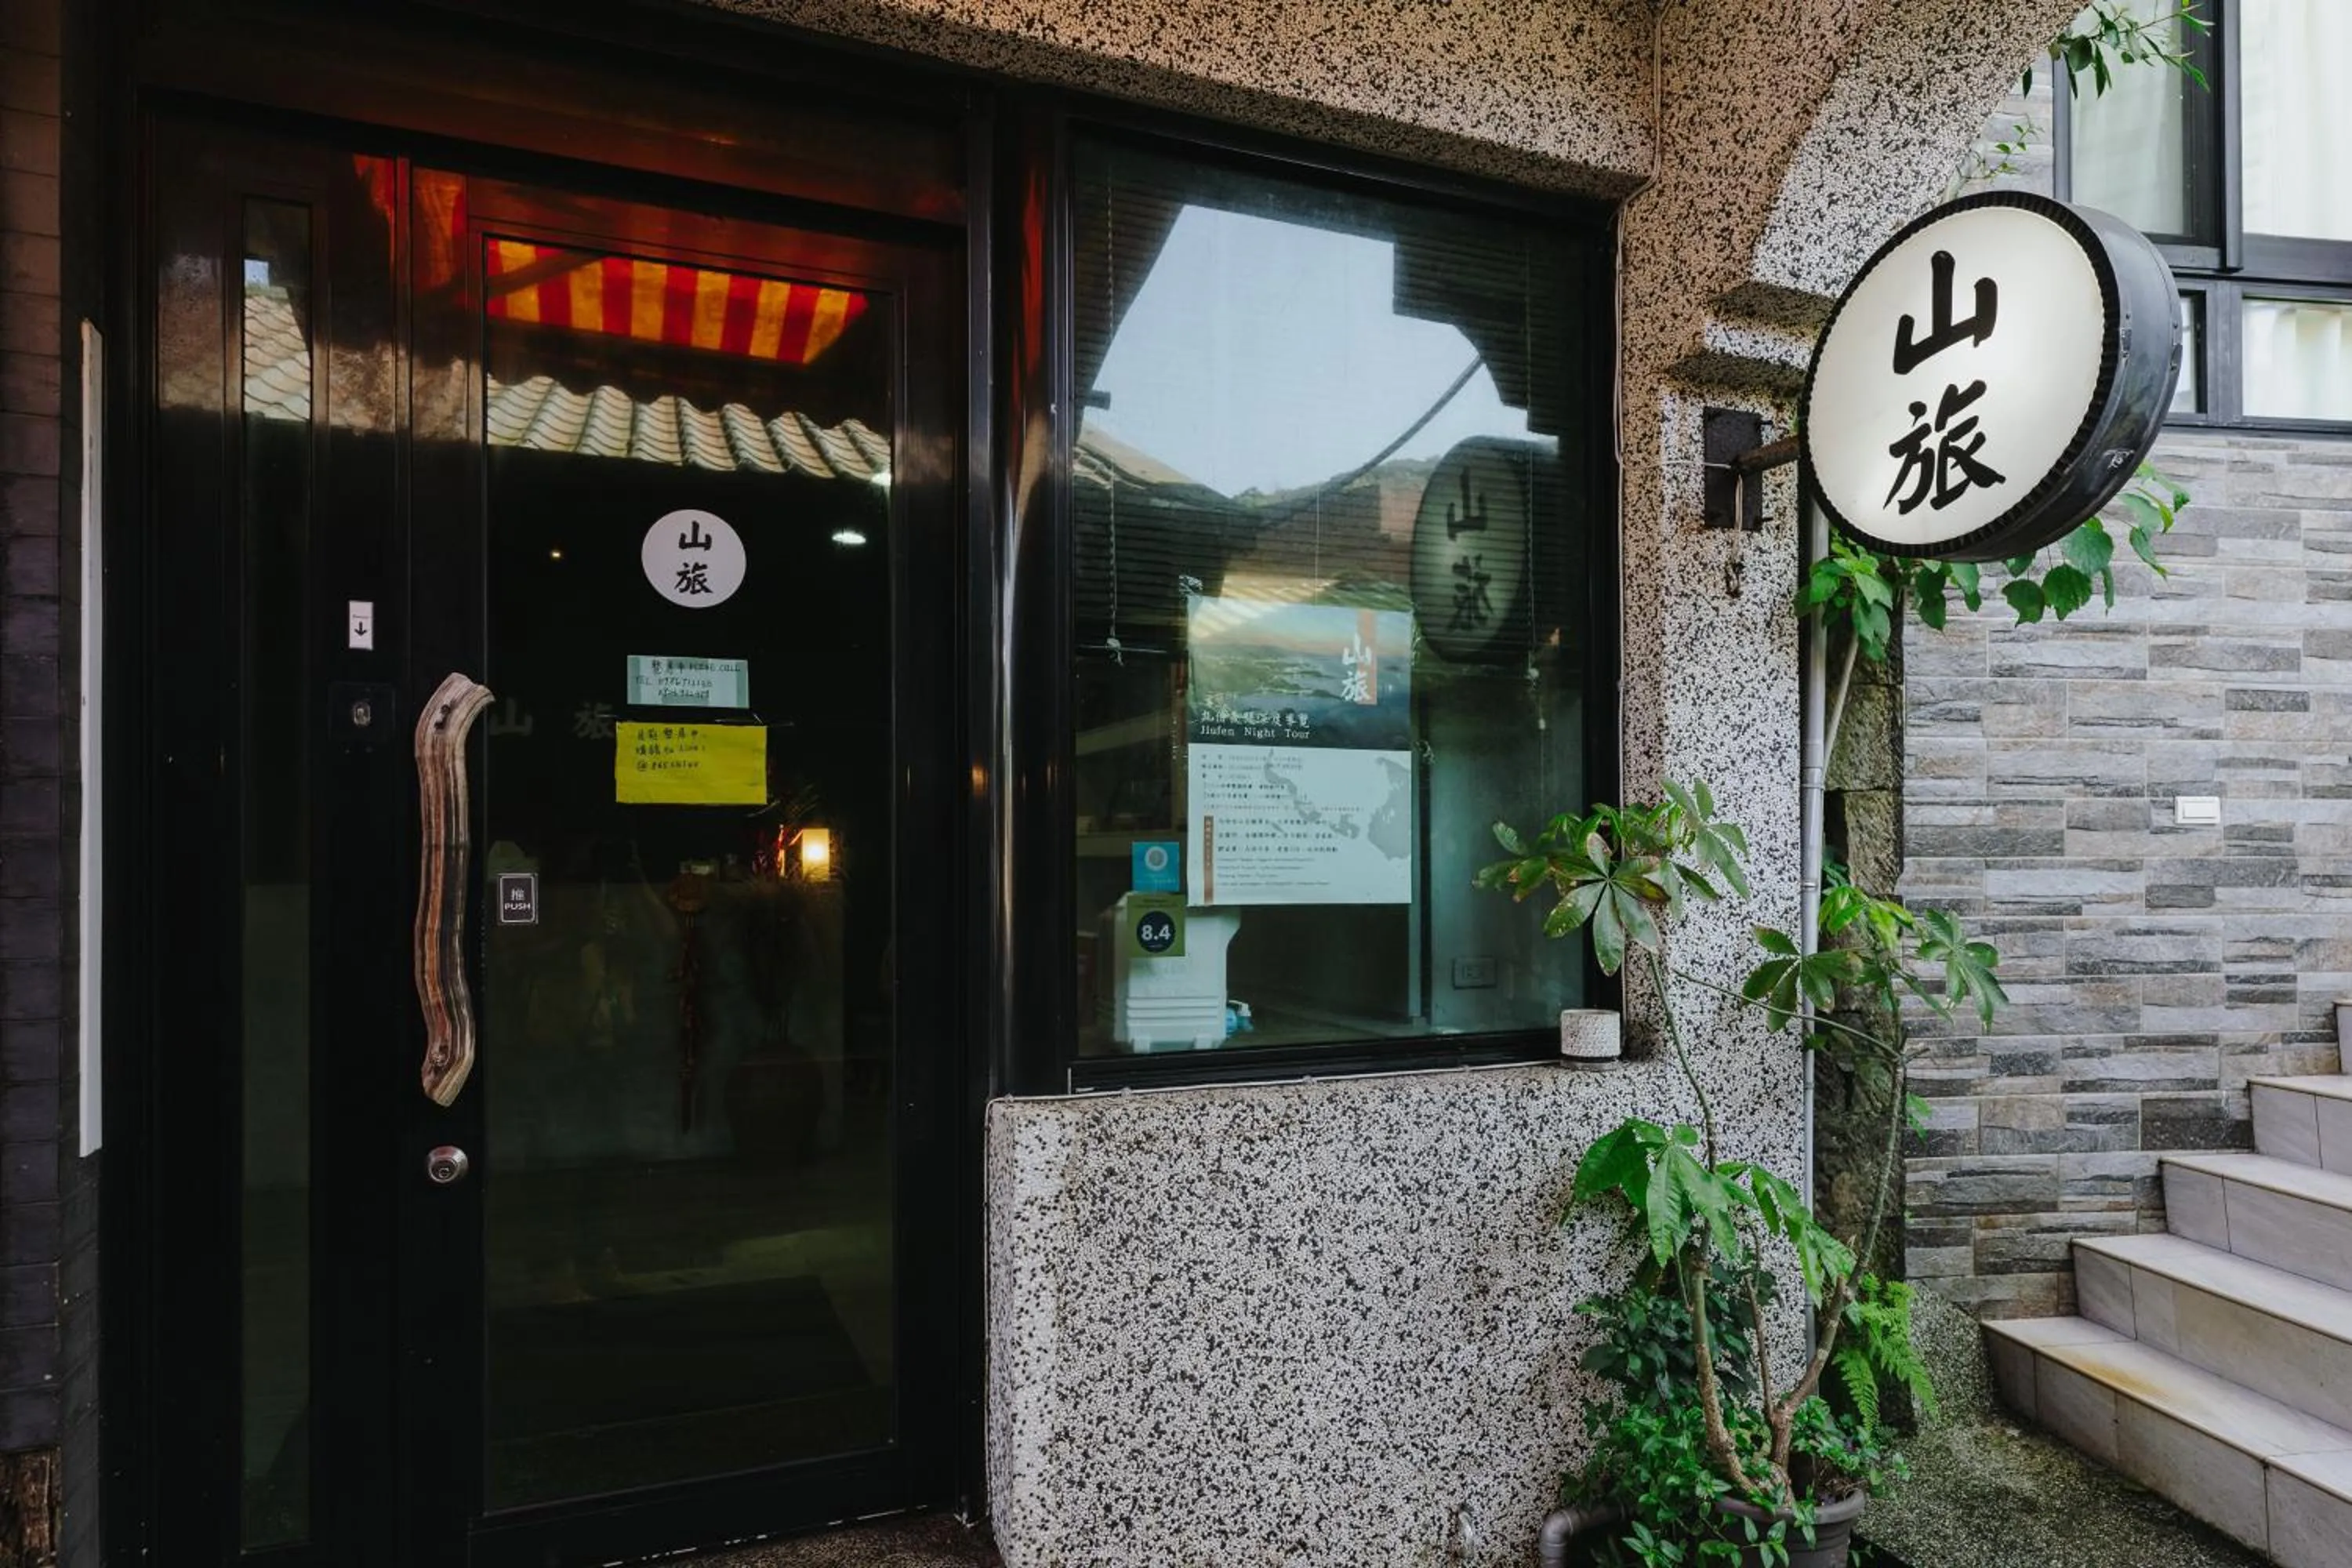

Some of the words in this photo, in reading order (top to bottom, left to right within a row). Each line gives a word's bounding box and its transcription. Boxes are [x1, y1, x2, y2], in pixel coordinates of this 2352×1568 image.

[1883, 249, 2006, 514] 山旅
[674, 521, 713, 595] 山旅
[1341, 633, 1372, 702] 山旅
[1200, 725, 1235, 737] Jiufen
[1243, 727, 1276, 739] Night
[1284, 728, 1310, 739] Tour
[511, 887, 525, 901] 推
[1141, 924, 1171, 941] 8.4
